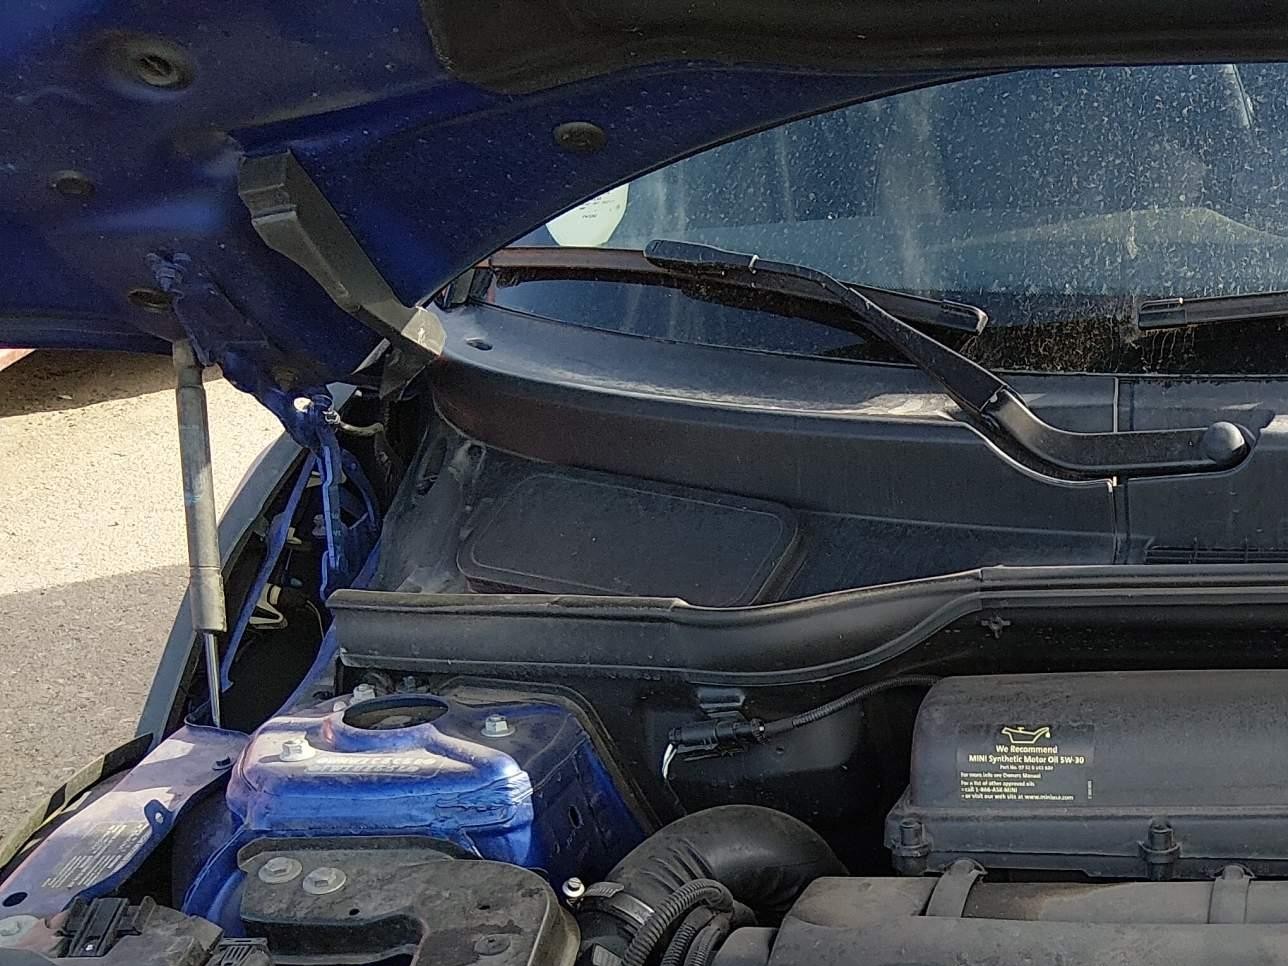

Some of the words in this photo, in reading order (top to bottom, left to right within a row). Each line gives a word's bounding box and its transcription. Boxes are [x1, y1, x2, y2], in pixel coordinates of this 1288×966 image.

[996, 745, 1008, 753] We
[1010, 745, 1058, 754] Recommend
[969, 754, 988, 763] MINI
[989, 754, 1022, 765] Synthetic
[1024, 755, 1046, 763] Motor
[1048, 755, 1059, 764] Oil
[1060, 756, 1085, 764] 5W-30
